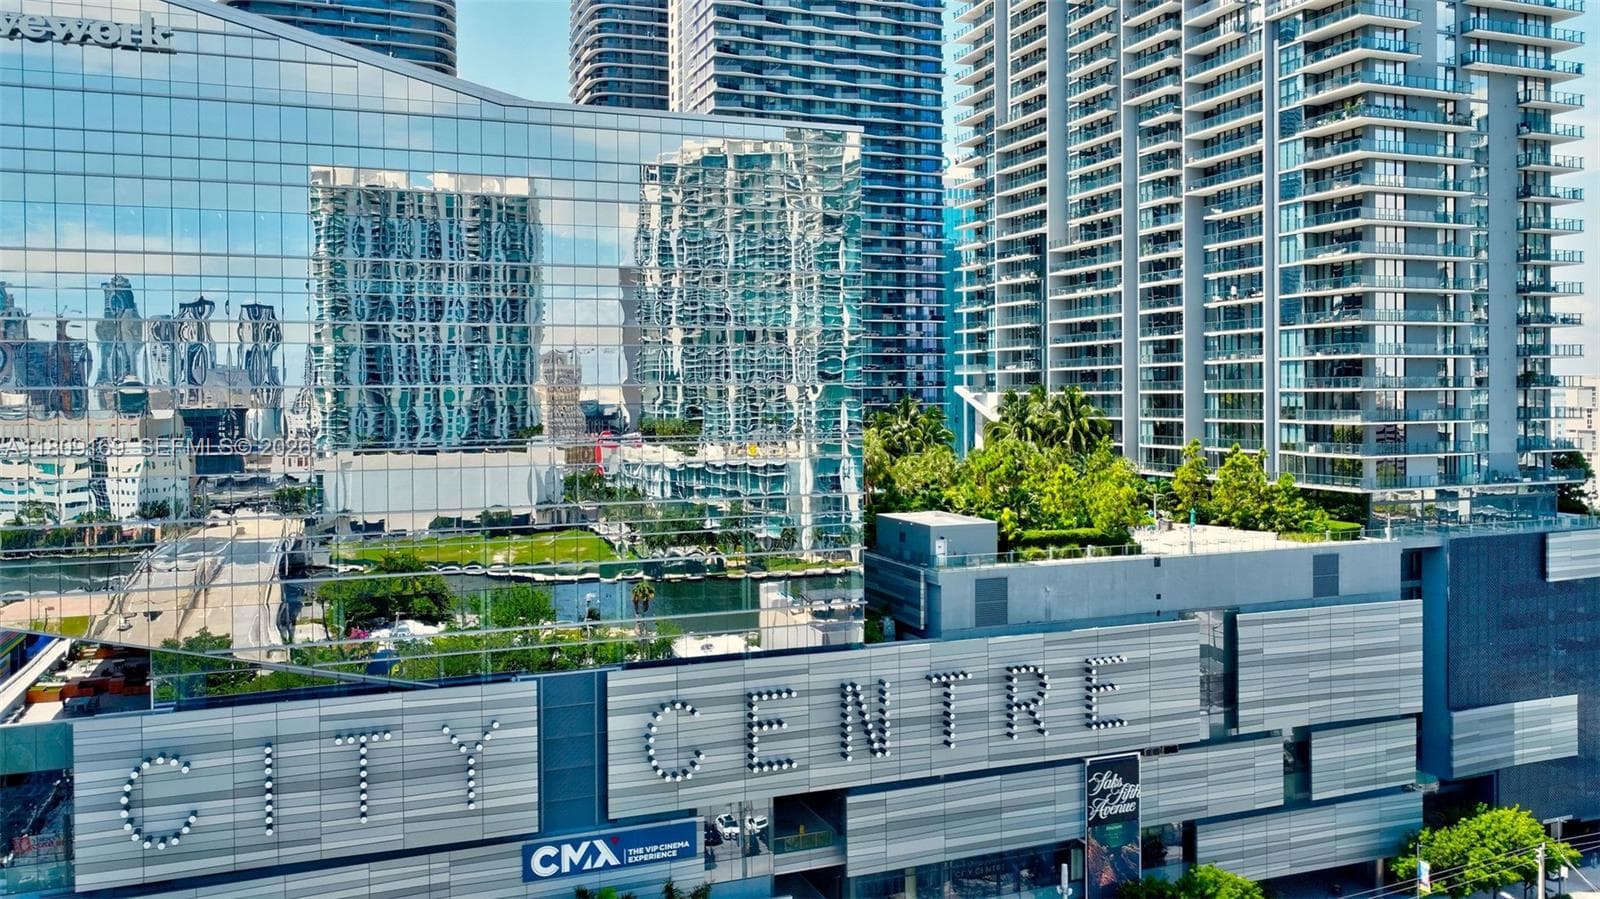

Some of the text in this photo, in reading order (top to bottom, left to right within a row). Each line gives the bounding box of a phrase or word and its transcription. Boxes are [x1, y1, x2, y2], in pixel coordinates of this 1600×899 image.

[120, 653, 1128, 850] CITY CENTRE
[1088, 770, 1122, 796] Saks
[1088, 798, 1136, 821] Avenue
[531, 839, 620, 877] CMX
[628, 840, 690, 857] THE VIP CINEMA
[628, 850, 677, 863] EXPERIENCE
